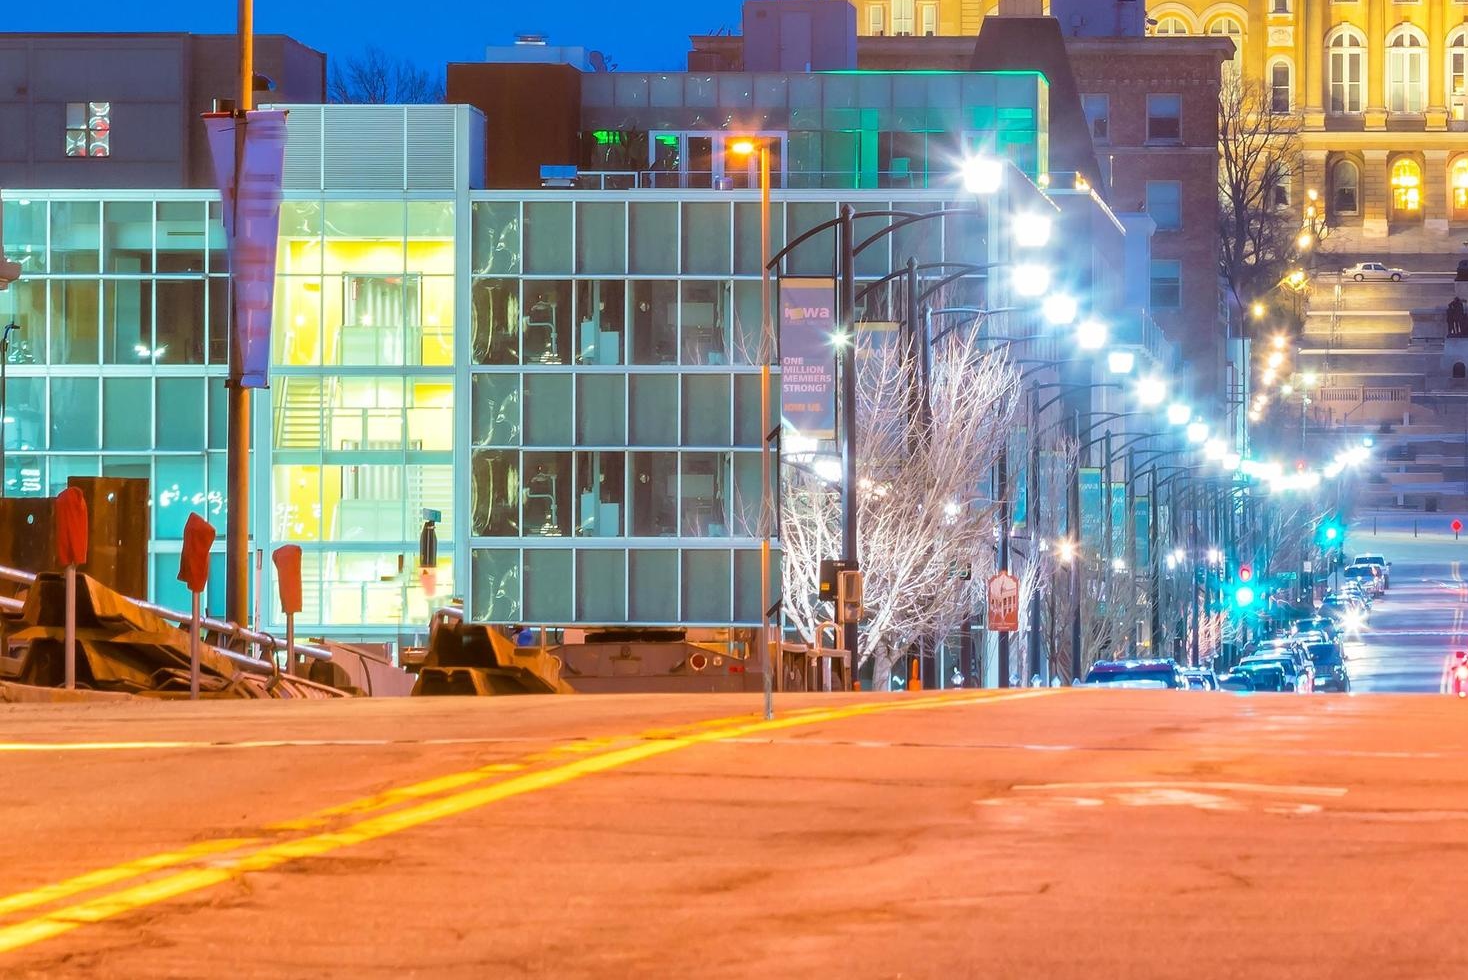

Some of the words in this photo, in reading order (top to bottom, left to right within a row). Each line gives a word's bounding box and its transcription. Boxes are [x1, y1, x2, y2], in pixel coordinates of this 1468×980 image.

[783, 356, 804, 365] ONE
[783, 365, 824, 374] MILLION
[783, 374, 832, 383] MEMBERS
[783, 384, 826, 393] STRONG!
